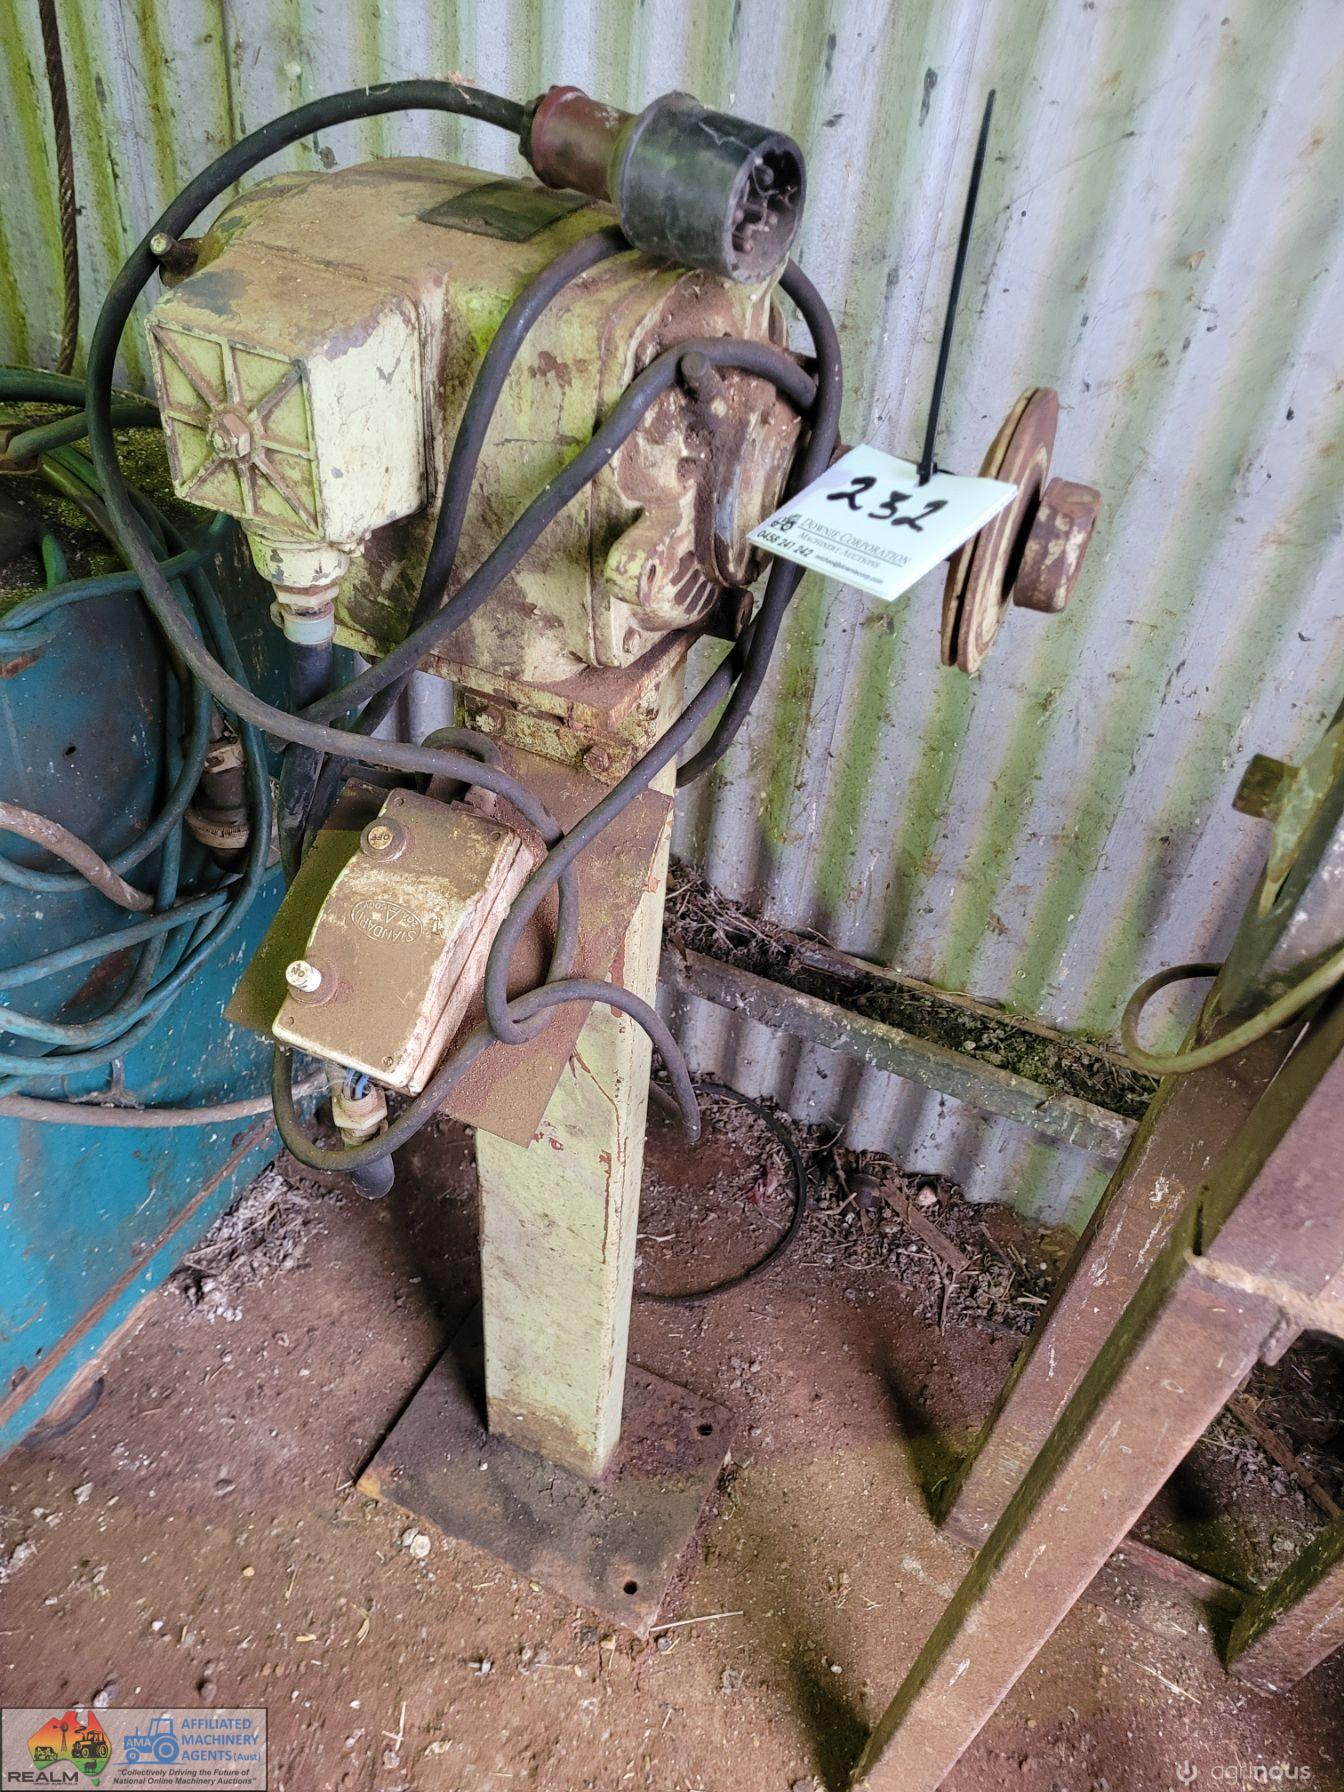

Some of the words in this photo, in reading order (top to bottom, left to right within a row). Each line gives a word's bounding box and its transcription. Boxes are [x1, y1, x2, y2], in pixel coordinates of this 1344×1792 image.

[826, 476, 948, 532] 232
[793, 545, 814, 557] 242
[839, 532, 911, 565] CORPORATION
[370, 833, 390, 841] OFF
[290, 966, 306, 978] ON
